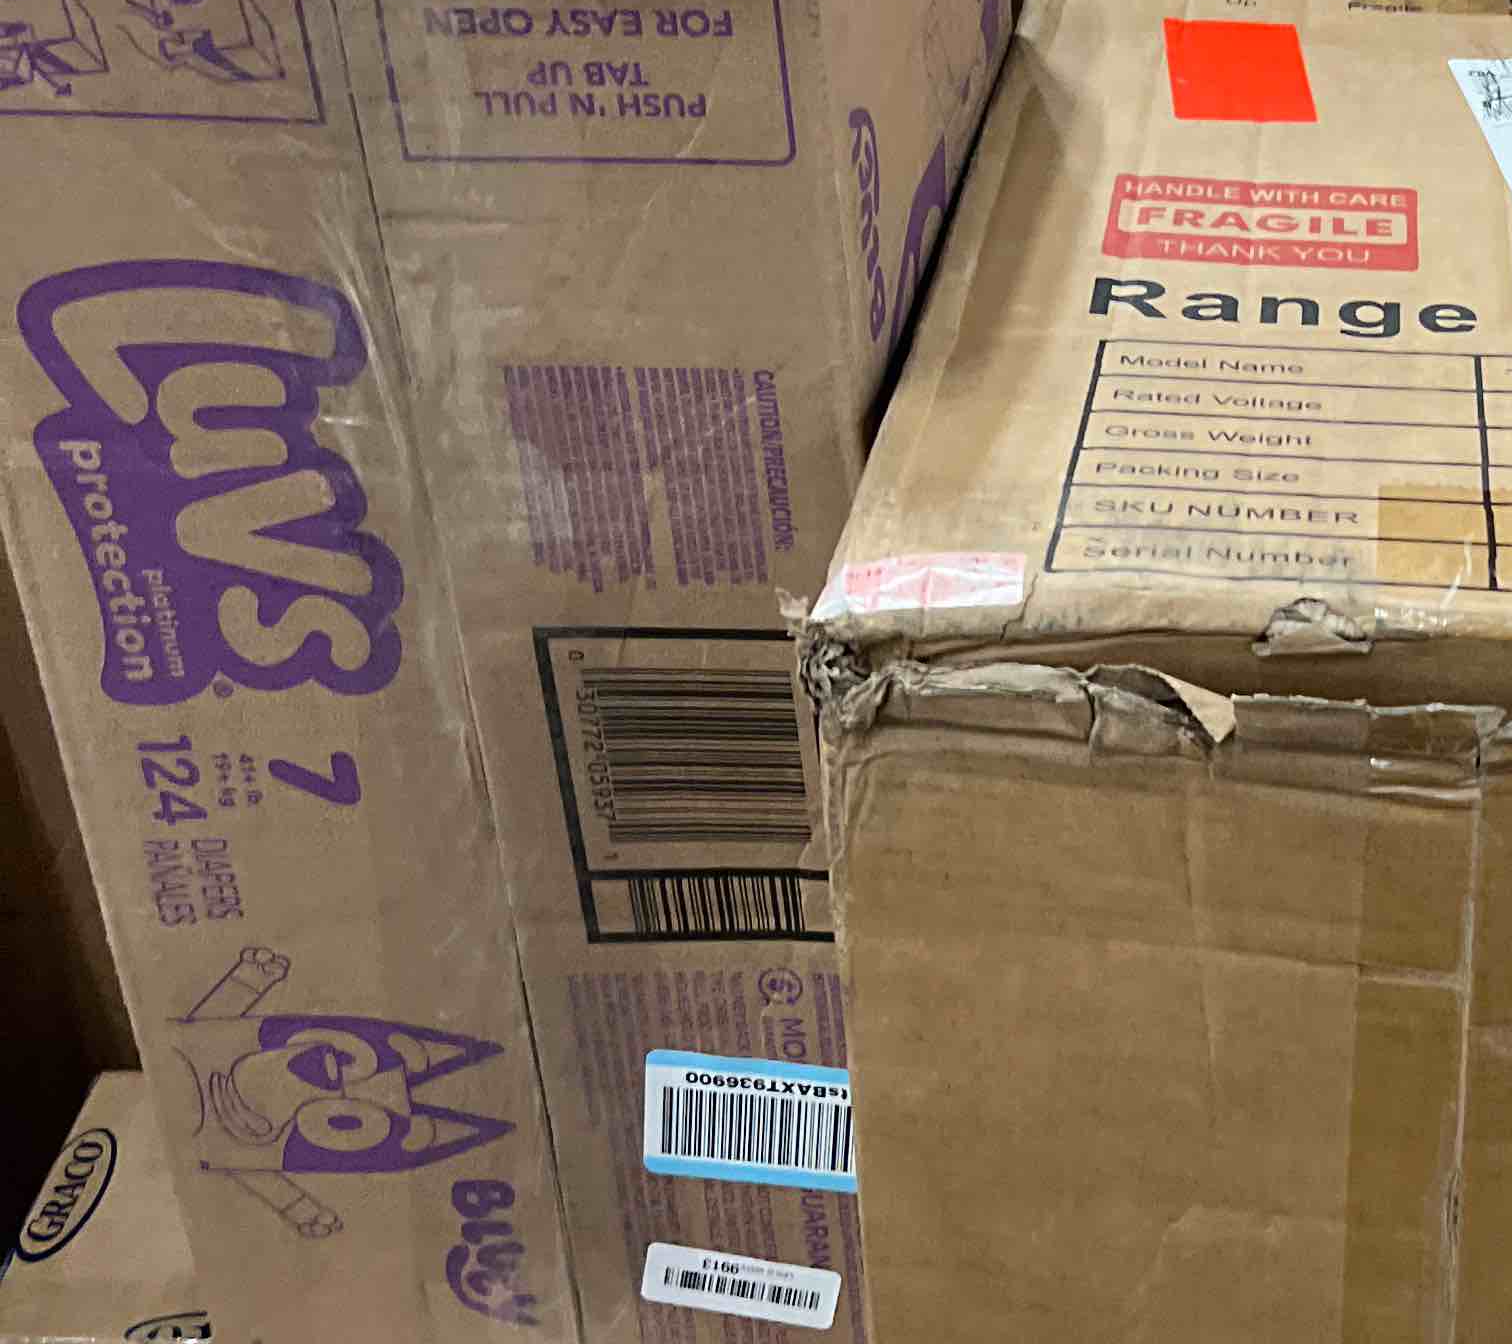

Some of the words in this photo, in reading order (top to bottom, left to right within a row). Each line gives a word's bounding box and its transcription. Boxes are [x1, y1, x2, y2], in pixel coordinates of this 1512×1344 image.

[426, 8, 534, 36] OPEN
[546, 8, 643, 36] EASY
[655, 8, 733, 36] FOR
[527, 60, 573, 87] UP
[584, 61, 650, 87] TAB
[473, 91, 557, 117] PULL
[615, 92, 707, 118] PUSH
[1122, 179, 1244, 204] HANDLE
[1249, 184, 1318, 206] WITH
[1327, 189, 1408, 209] CARE
[1135, 204, 1396, 239] FRAGILE
[1158, 239, 1289, 263] THANK
[1297, 243, 1371, 265] YOU
[1088, 276, 1477, 338] Range
[1119, 353, 1209, 372] Model
[1217, 358, 1304, 375] Name
[1112, 387, 1201, 405] Rated
[1211, 392, 1323, 412] Voltage
[1103, 423, 1195, 441] Gross
[1205, 429, 1313, 448] Weight
[32, 268, 395, 686] Luvs
[1094, 460, 1220, 482] Packing
[1231, 466, 1301, 482] Size
[1092, 500, 1175, 516] SKU
[1187, 504, 1360, 524] NUMBER
[59, 437, 154, 683] protection
[1082, 540, 1193, 561] Serial
[1209, 547, 1354, 568] Number
[141, 567, 185, 682] platinum
[136, 735, 208, 826] 124
[268, 751, 361, 807] 7
[191, 839, 244, 920] DIAPERS
[26, 1139, 104, 1244] GRACO
[443, 1177, 542, 1329] BLUEY
